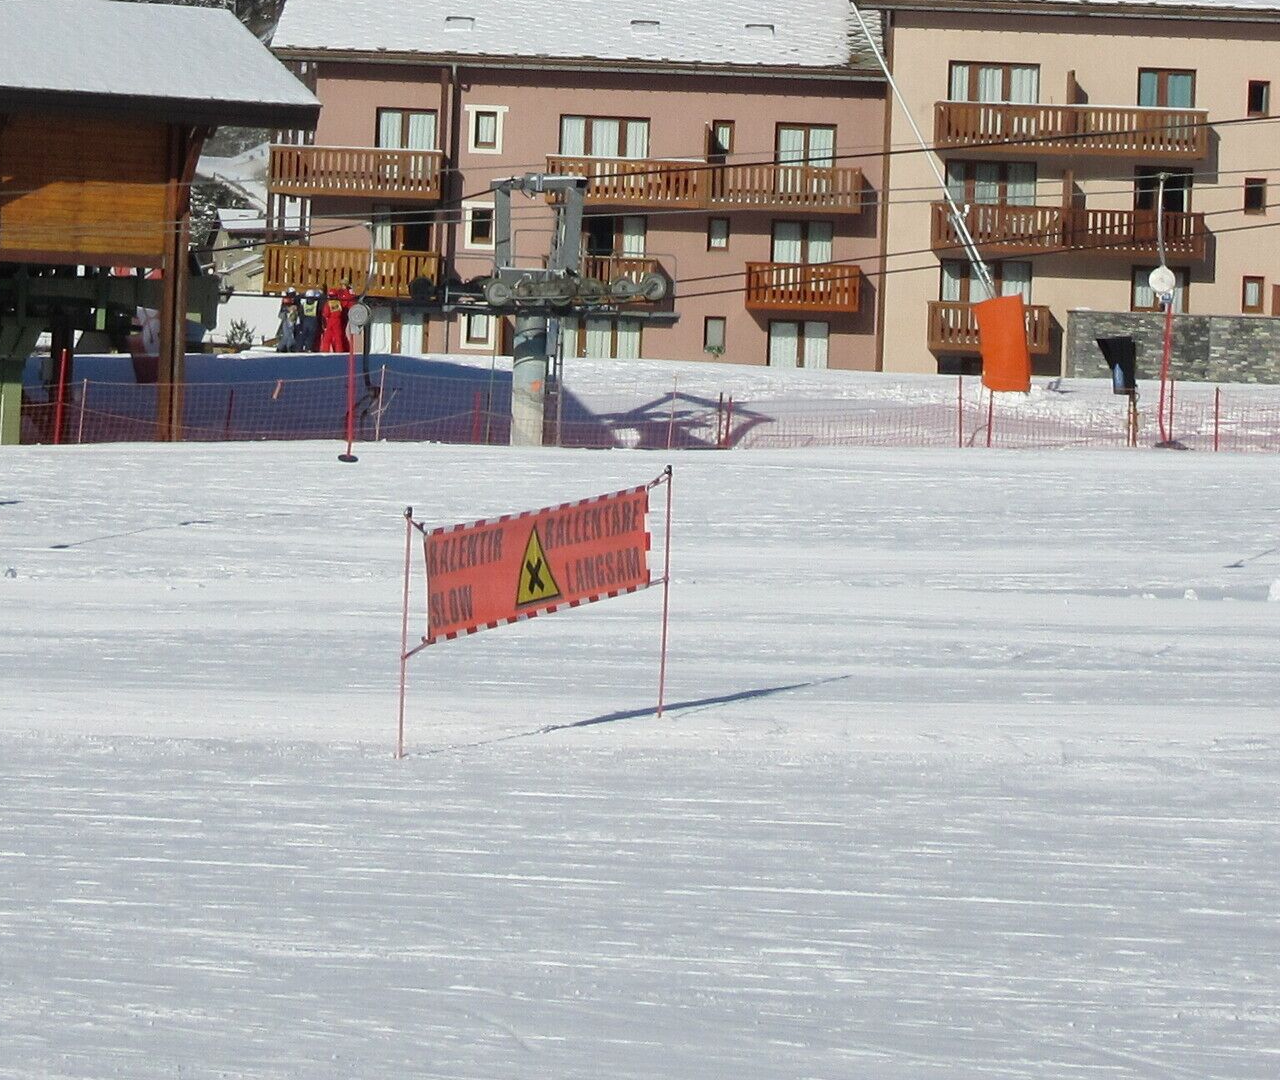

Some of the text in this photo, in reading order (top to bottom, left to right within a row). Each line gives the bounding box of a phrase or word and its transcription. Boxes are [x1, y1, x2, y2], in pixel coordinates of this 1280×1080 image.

[544, 499, 641, 551] RALLENTARE
[429, 528, 504, 577] RALENTIR
[565, 546, 641, 593] LANGSAM
[431, 584, 473, 628] SLOW
